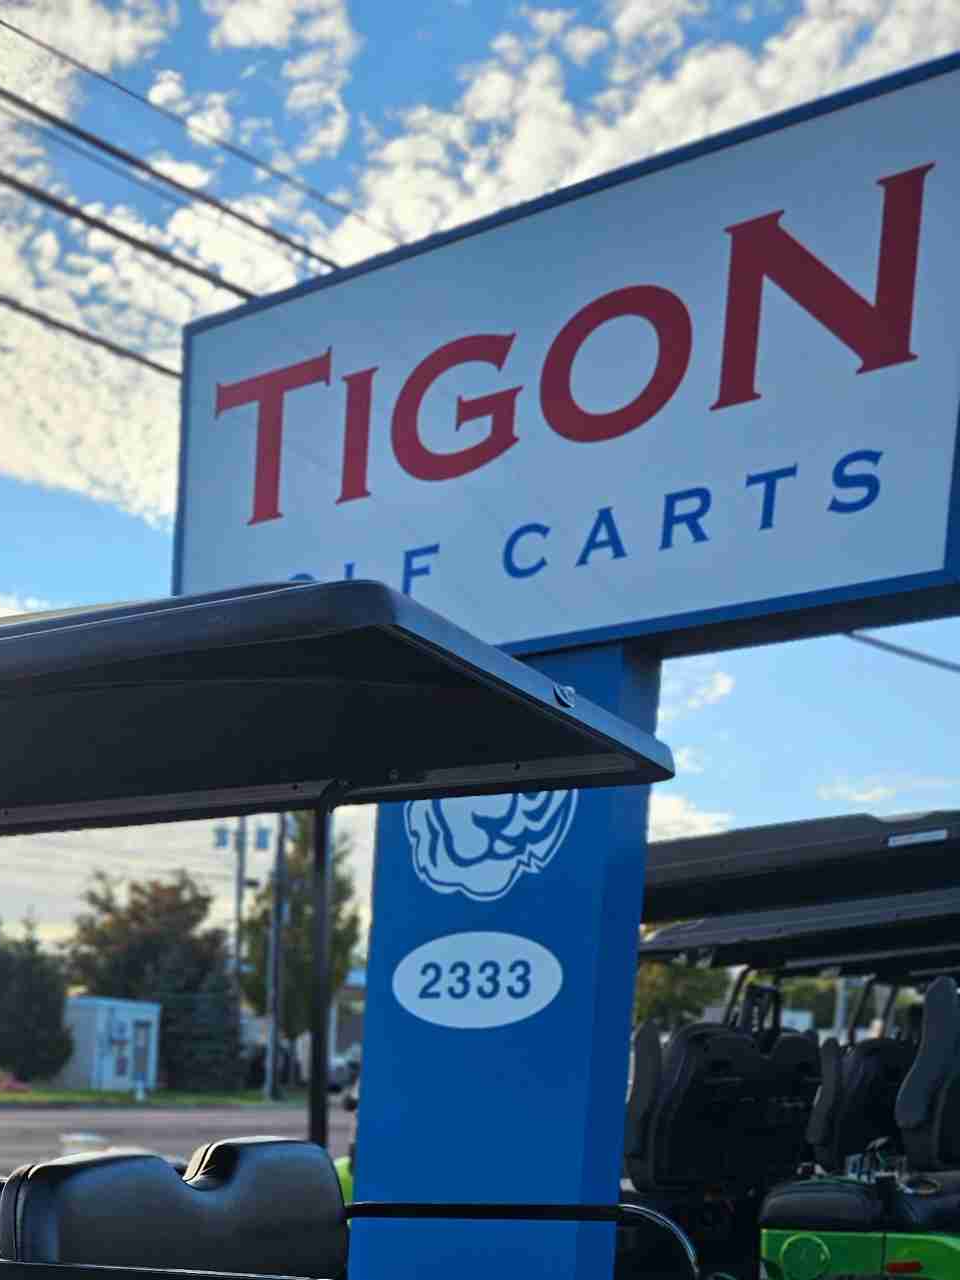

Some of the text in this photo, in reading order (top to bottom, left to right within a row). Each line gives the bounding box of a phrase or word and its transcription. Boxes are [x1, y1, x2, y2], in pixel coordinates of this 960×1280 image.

[215, 161, 936, 526] TIGON
[501, 449, 884, 581] CARTS
[418, 959, 532, 1000] 2333
